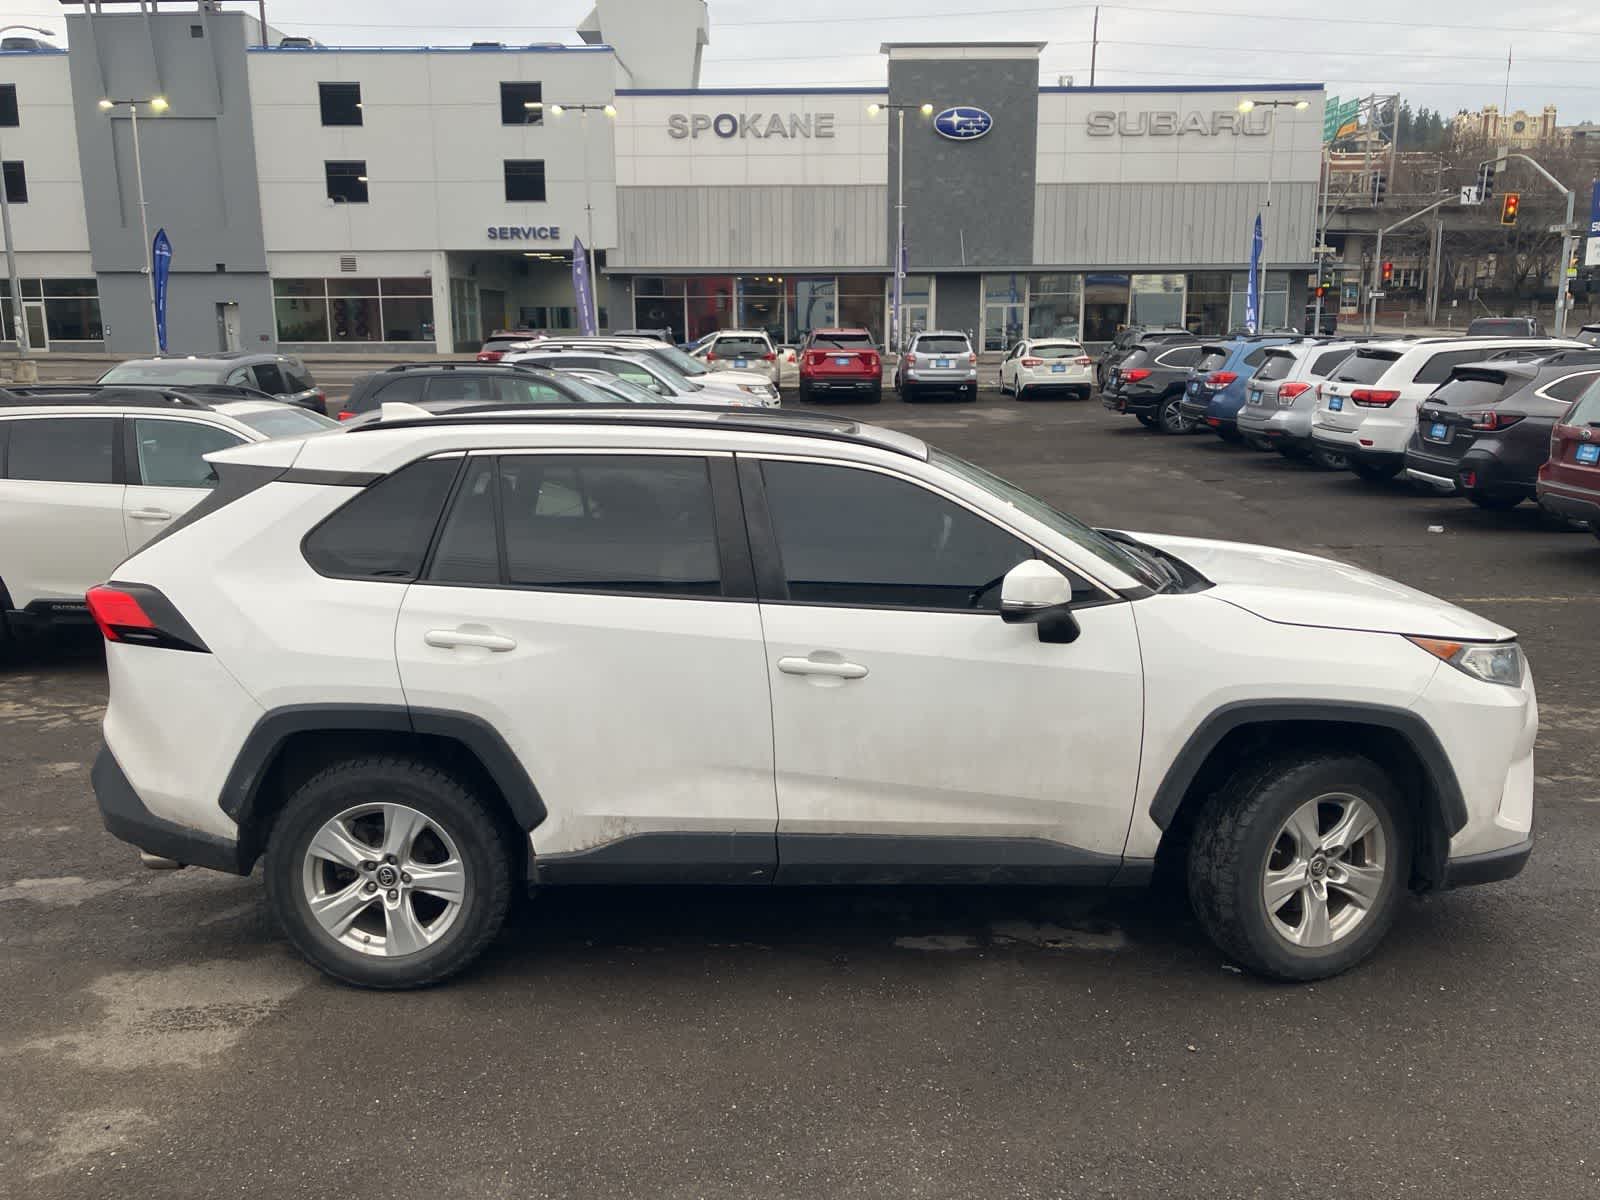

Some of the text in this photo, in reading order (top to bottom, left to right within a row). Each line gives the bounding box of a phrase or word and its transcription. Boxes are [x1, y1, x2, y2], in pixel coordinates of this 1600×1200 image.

[667, 113, 836, 139] SPOKANE
[1087, 111, 1273, 137] SUBARU
[487, 226, 560, 240] SERVICE
